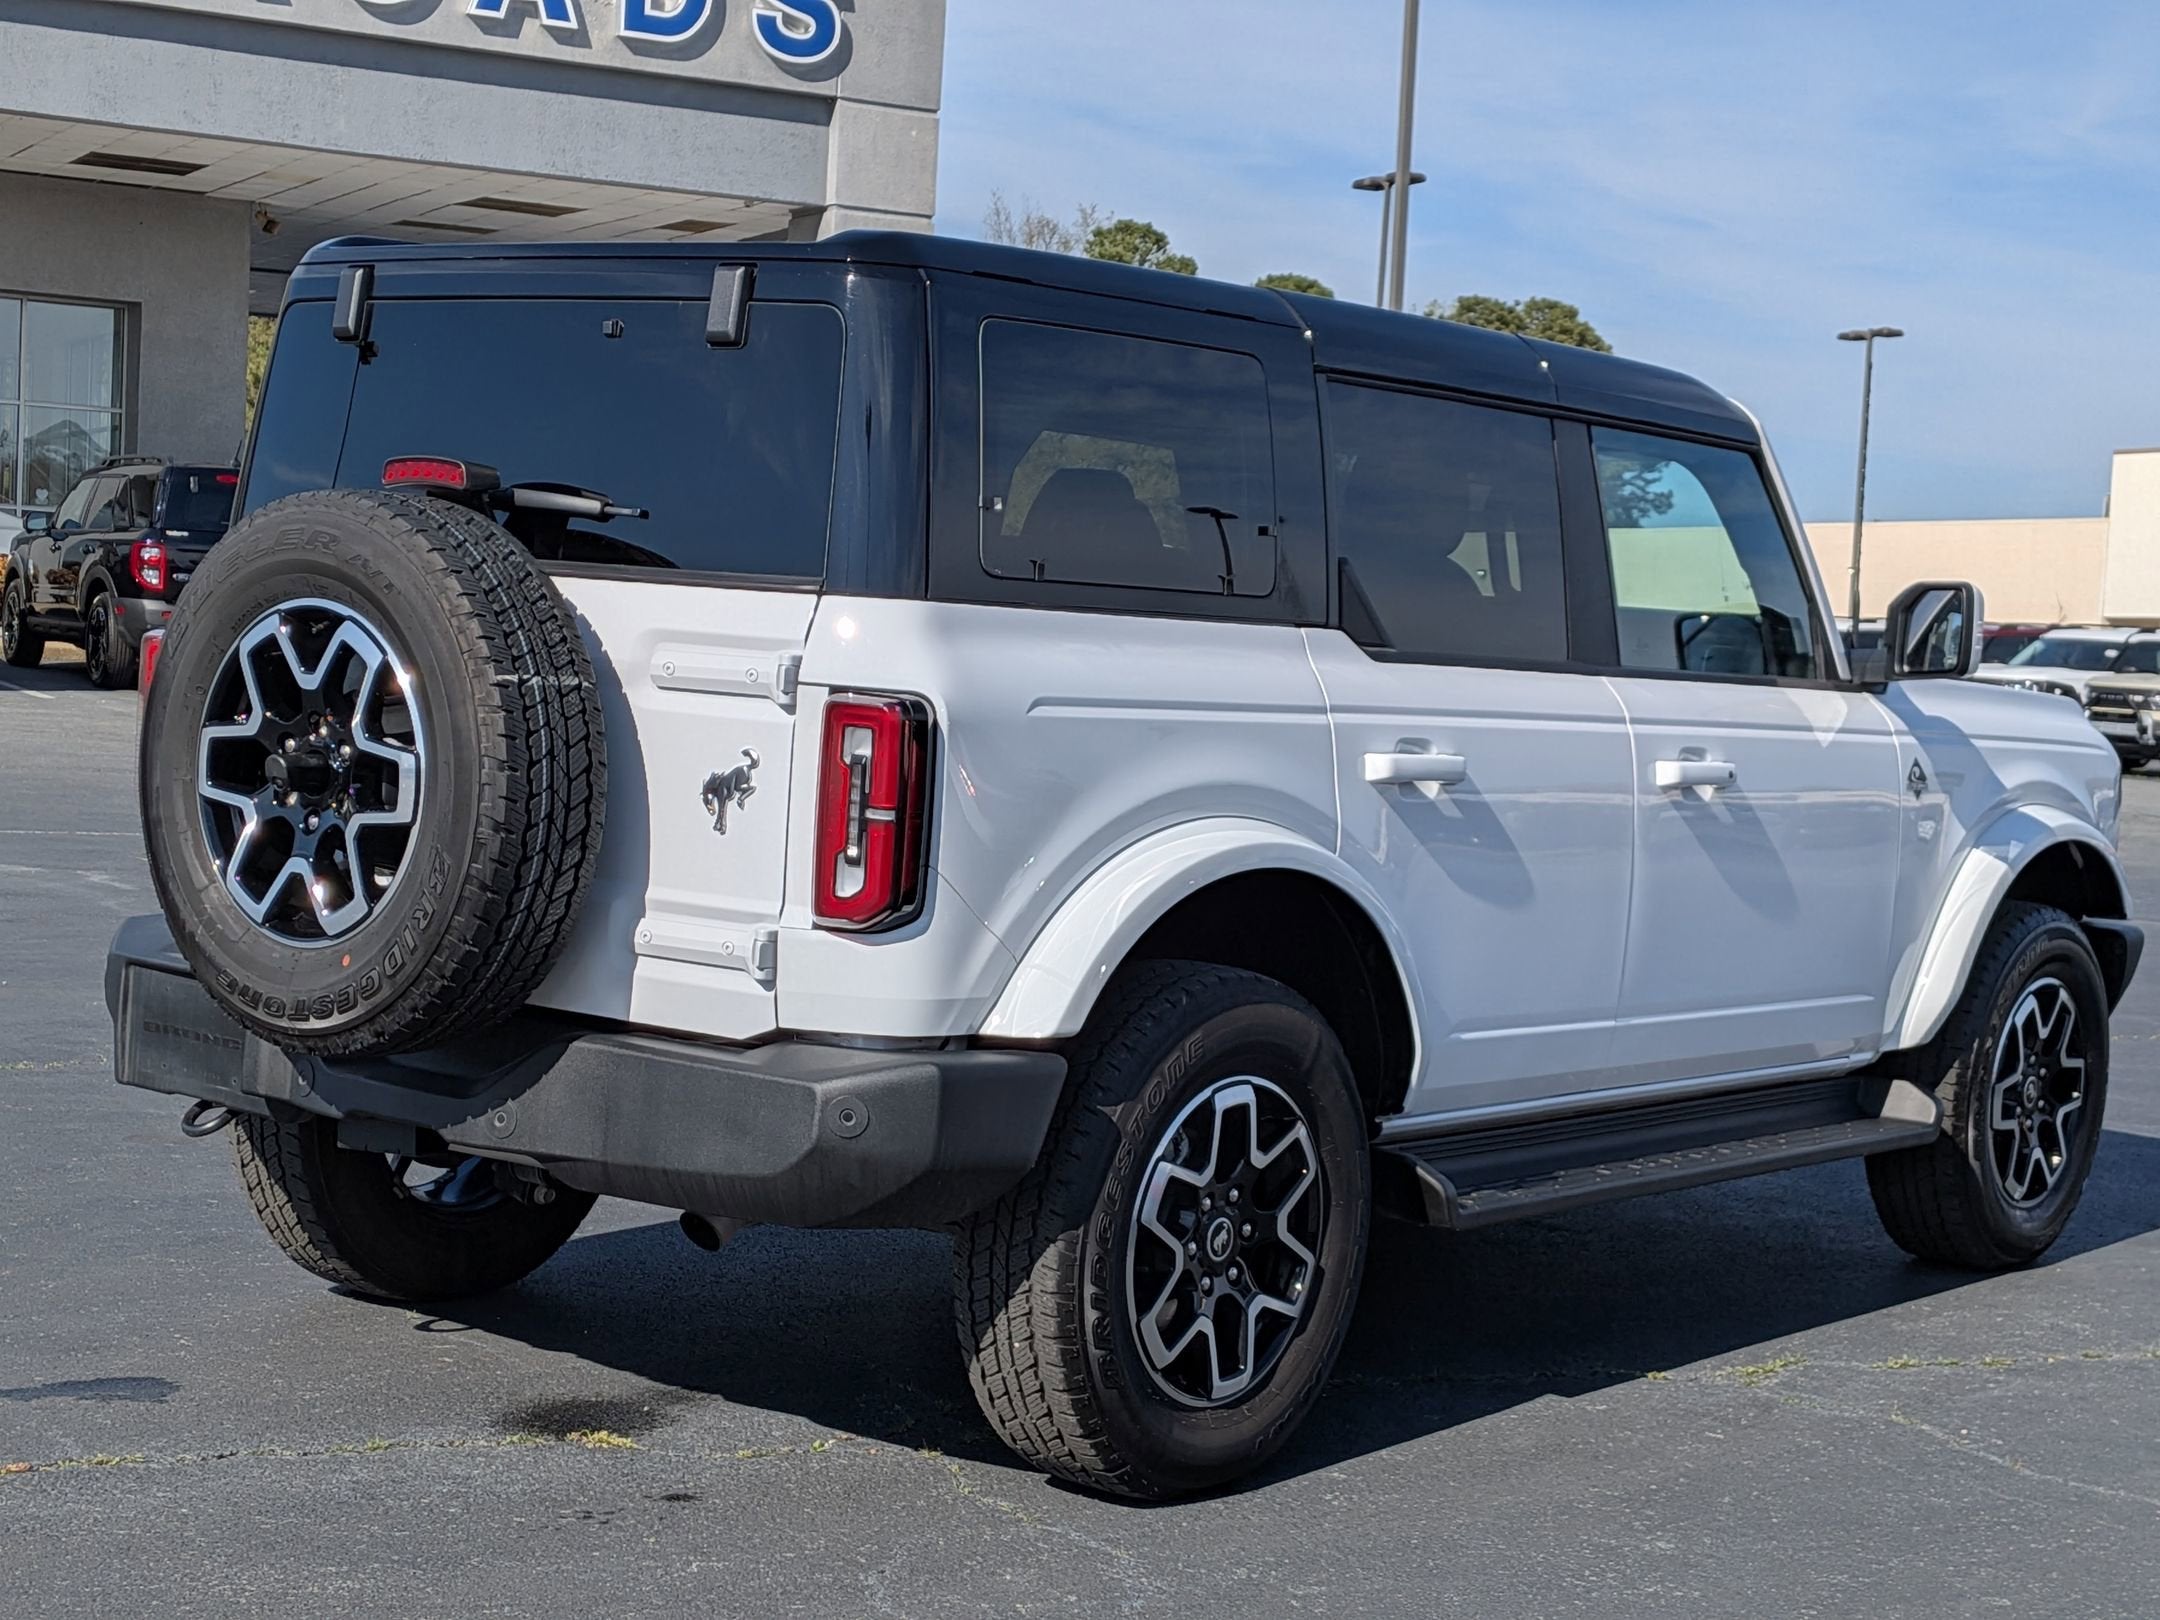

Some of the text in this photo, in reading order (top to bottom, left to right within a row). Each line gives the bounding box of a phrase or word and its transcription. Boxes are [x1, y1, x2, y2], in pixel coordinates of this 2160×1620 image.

[216, 845, 453, 1022] BRIDGESTONE
[142, 1019, 242, 1051] BRONC
[1090, 1032, 1206, 1391] BRIDGESTONE
